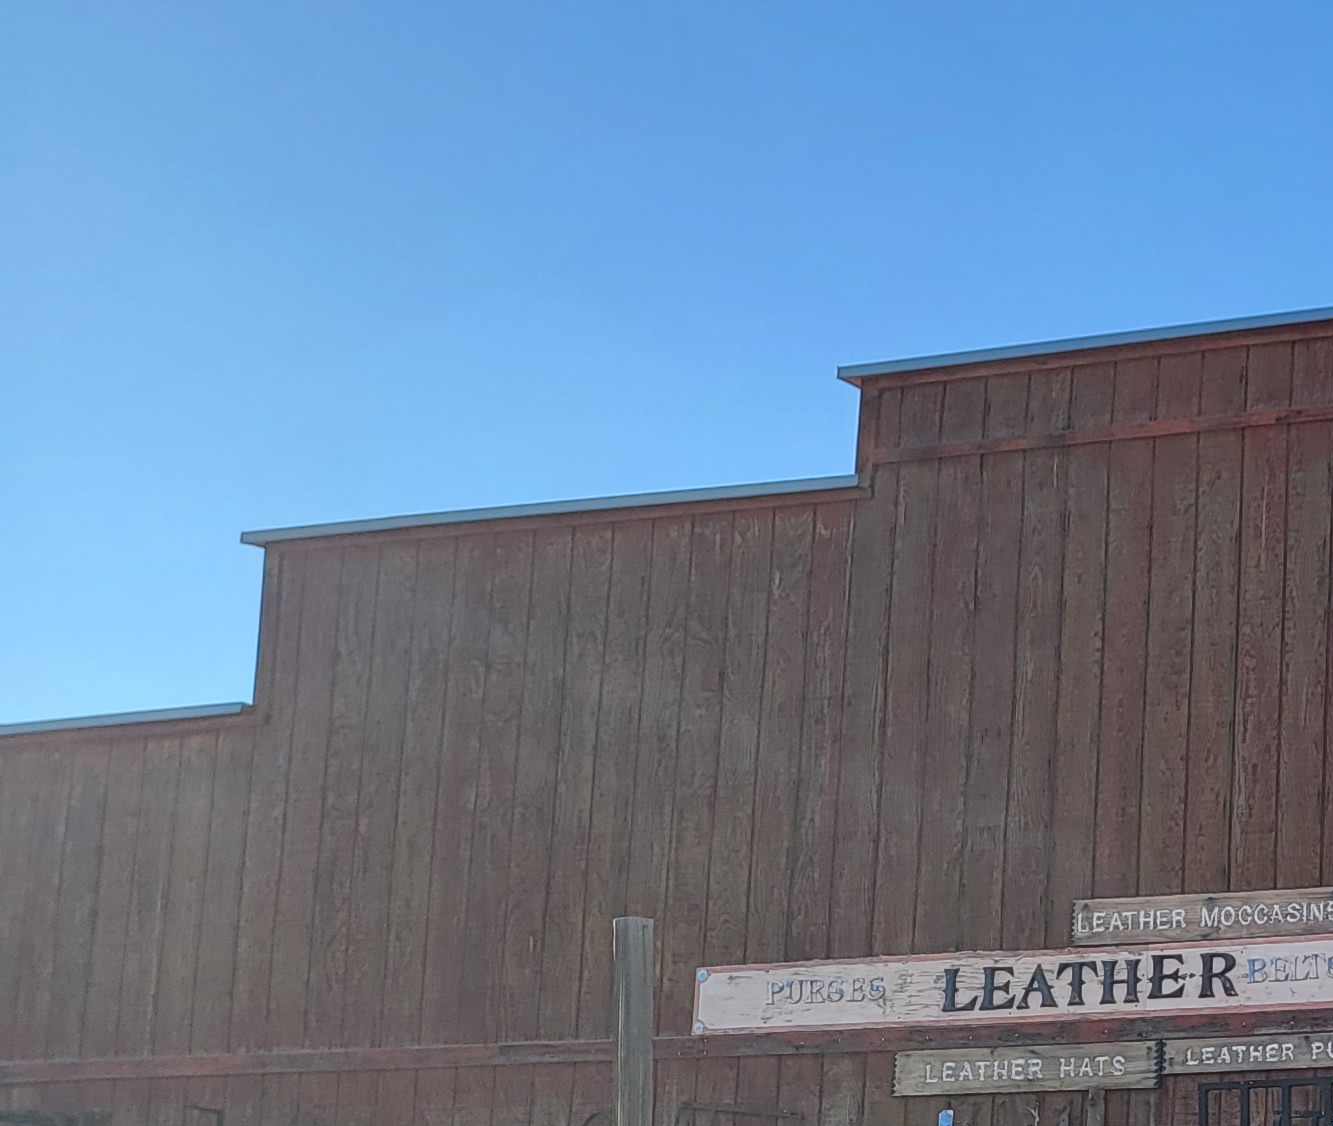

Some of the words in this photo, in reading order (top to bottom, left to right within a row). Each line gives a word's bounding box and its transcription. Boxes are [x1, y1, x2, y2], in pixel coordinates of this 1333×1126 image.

[1077, 909, 1186, 934] LEATHER
[766, 977, 886, 1005] PURSES
[942, 952, 1239, 1012] LEATHER
[1186, 1043, 1294, 1066] LEATHER
[925, 1057, 1043, 1083] LEATHER
[1059, 1055, 1126, 1079] HATS
